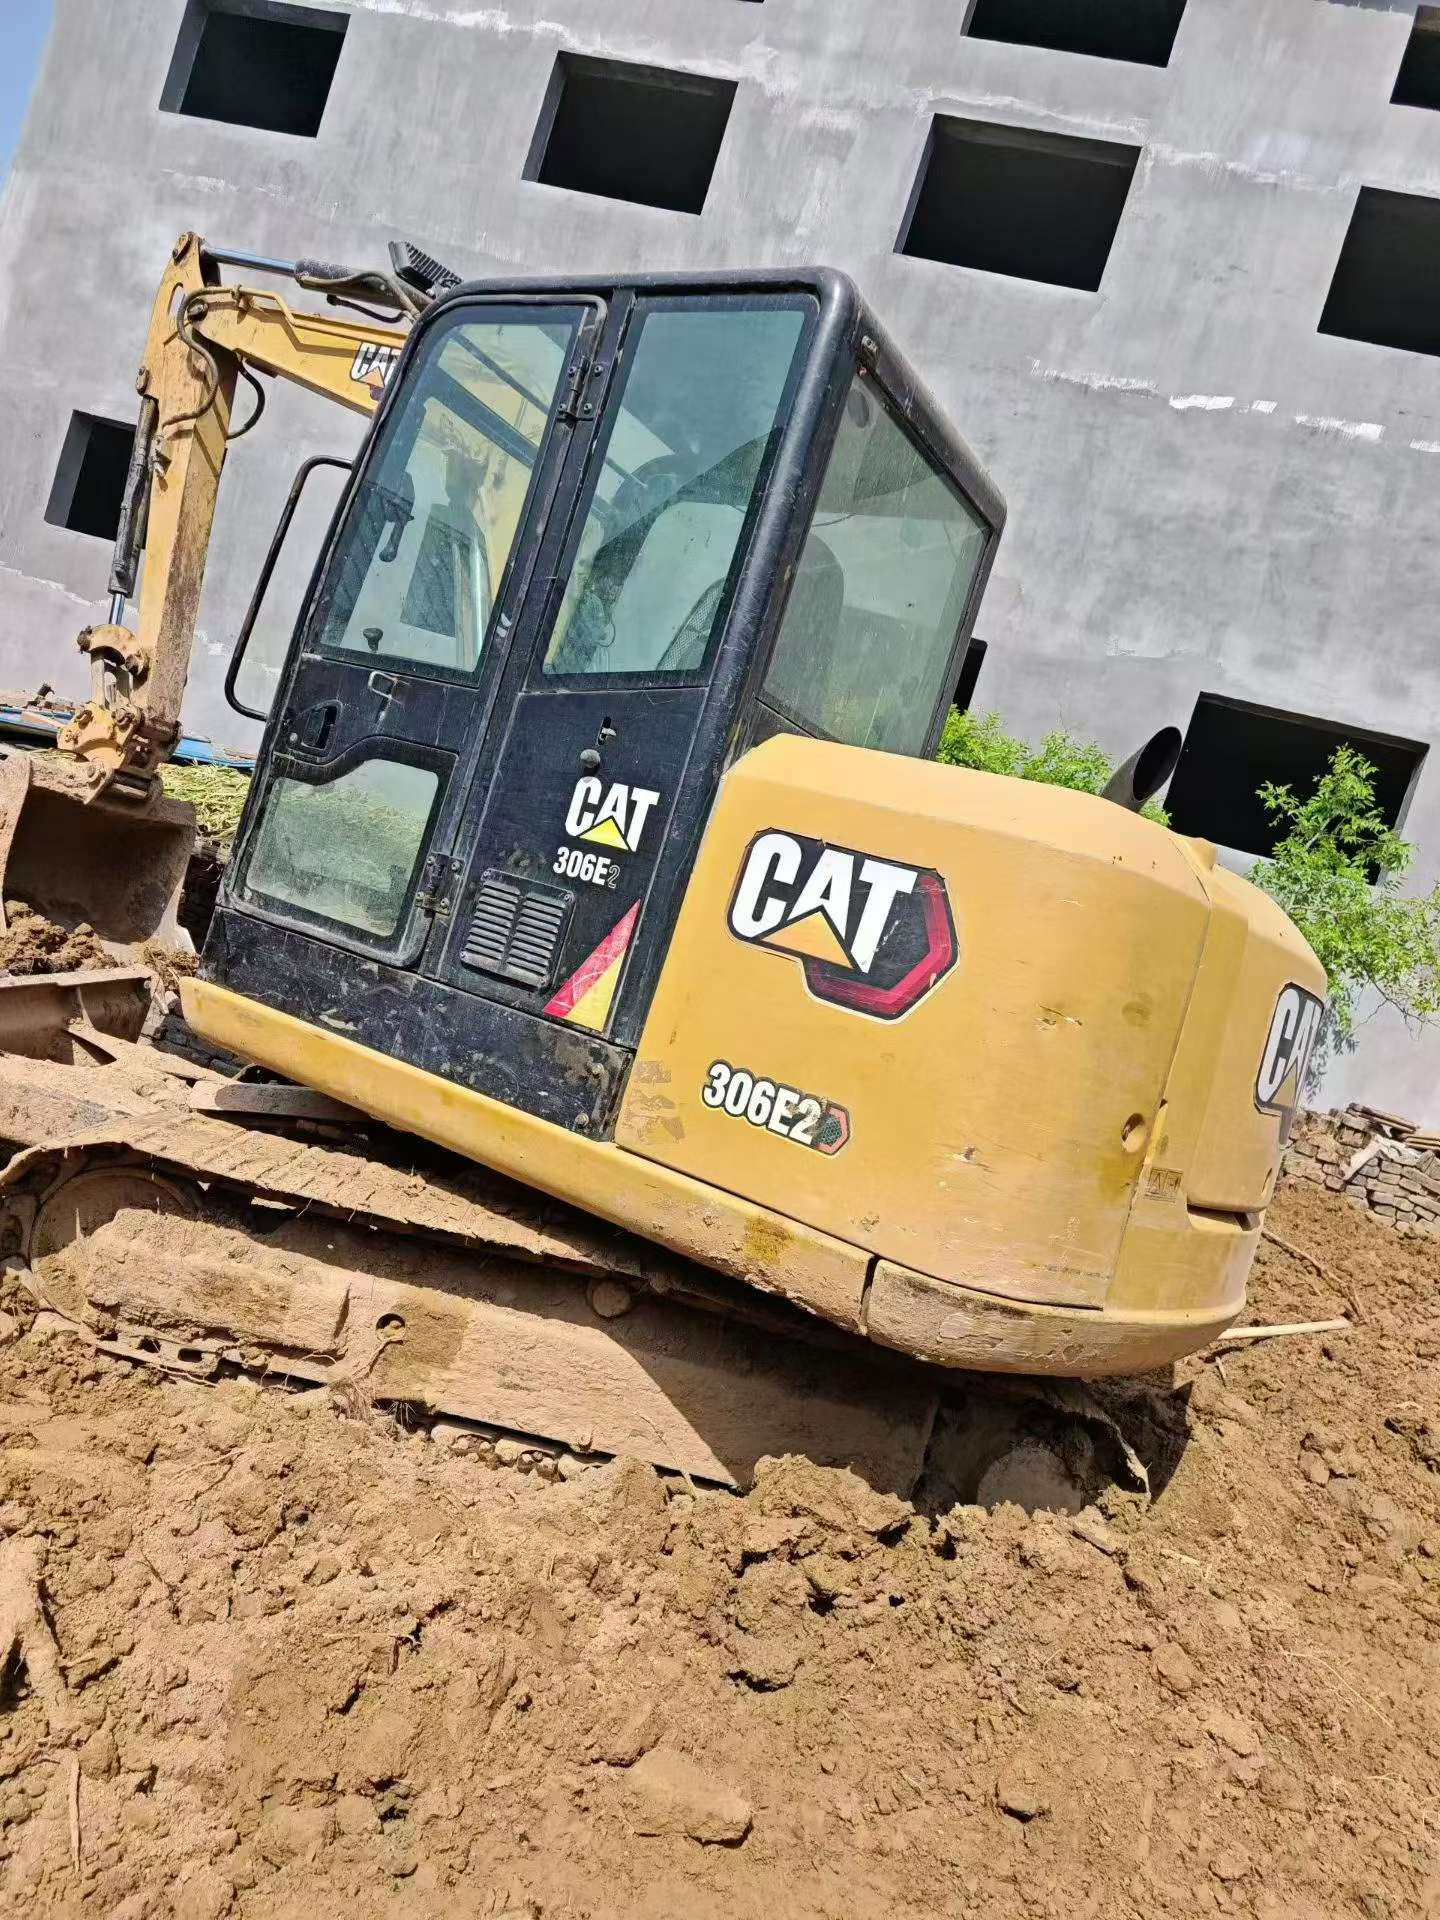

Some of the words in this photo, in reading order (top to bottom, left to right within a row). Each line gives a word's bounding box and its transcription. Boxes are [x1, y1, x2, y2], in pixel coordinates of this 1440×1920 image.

[565, 776, 660, 852] CAT
[553, 847, 620, 888] 306E2
[732, 833, 918, 973] CAT
[703, 1063, 822, 1145] 306E2
